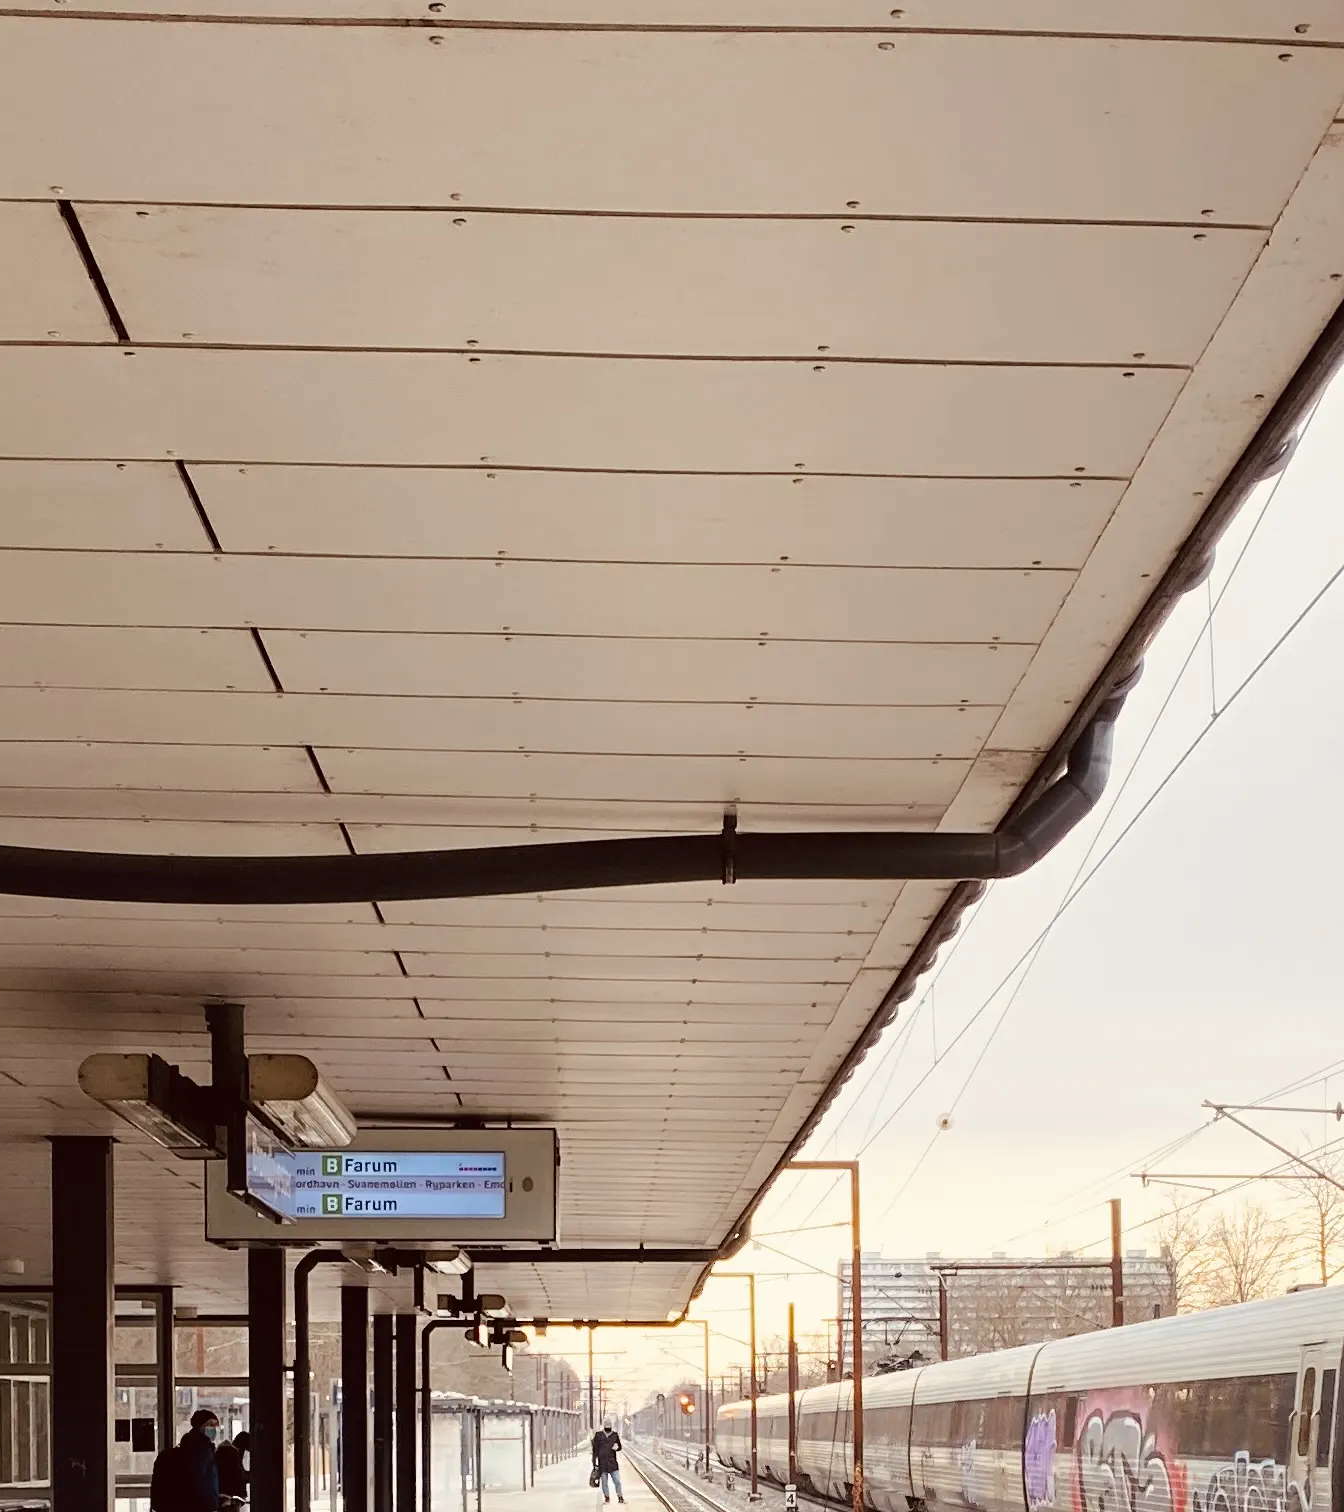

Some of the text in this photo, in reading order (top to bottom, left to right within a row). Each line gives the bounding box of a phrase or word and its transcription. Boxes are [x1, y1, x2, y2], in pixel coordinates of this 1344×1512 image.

[296, 1158, 397, 1176] min B Farum
[296, 1180, 339, 1189] ordhavn
[425, 1179, 475, 1191] Ryparken
[296, 1196, 397, 1214] min B Farum
[786, 1493, 795, 1505] 4
